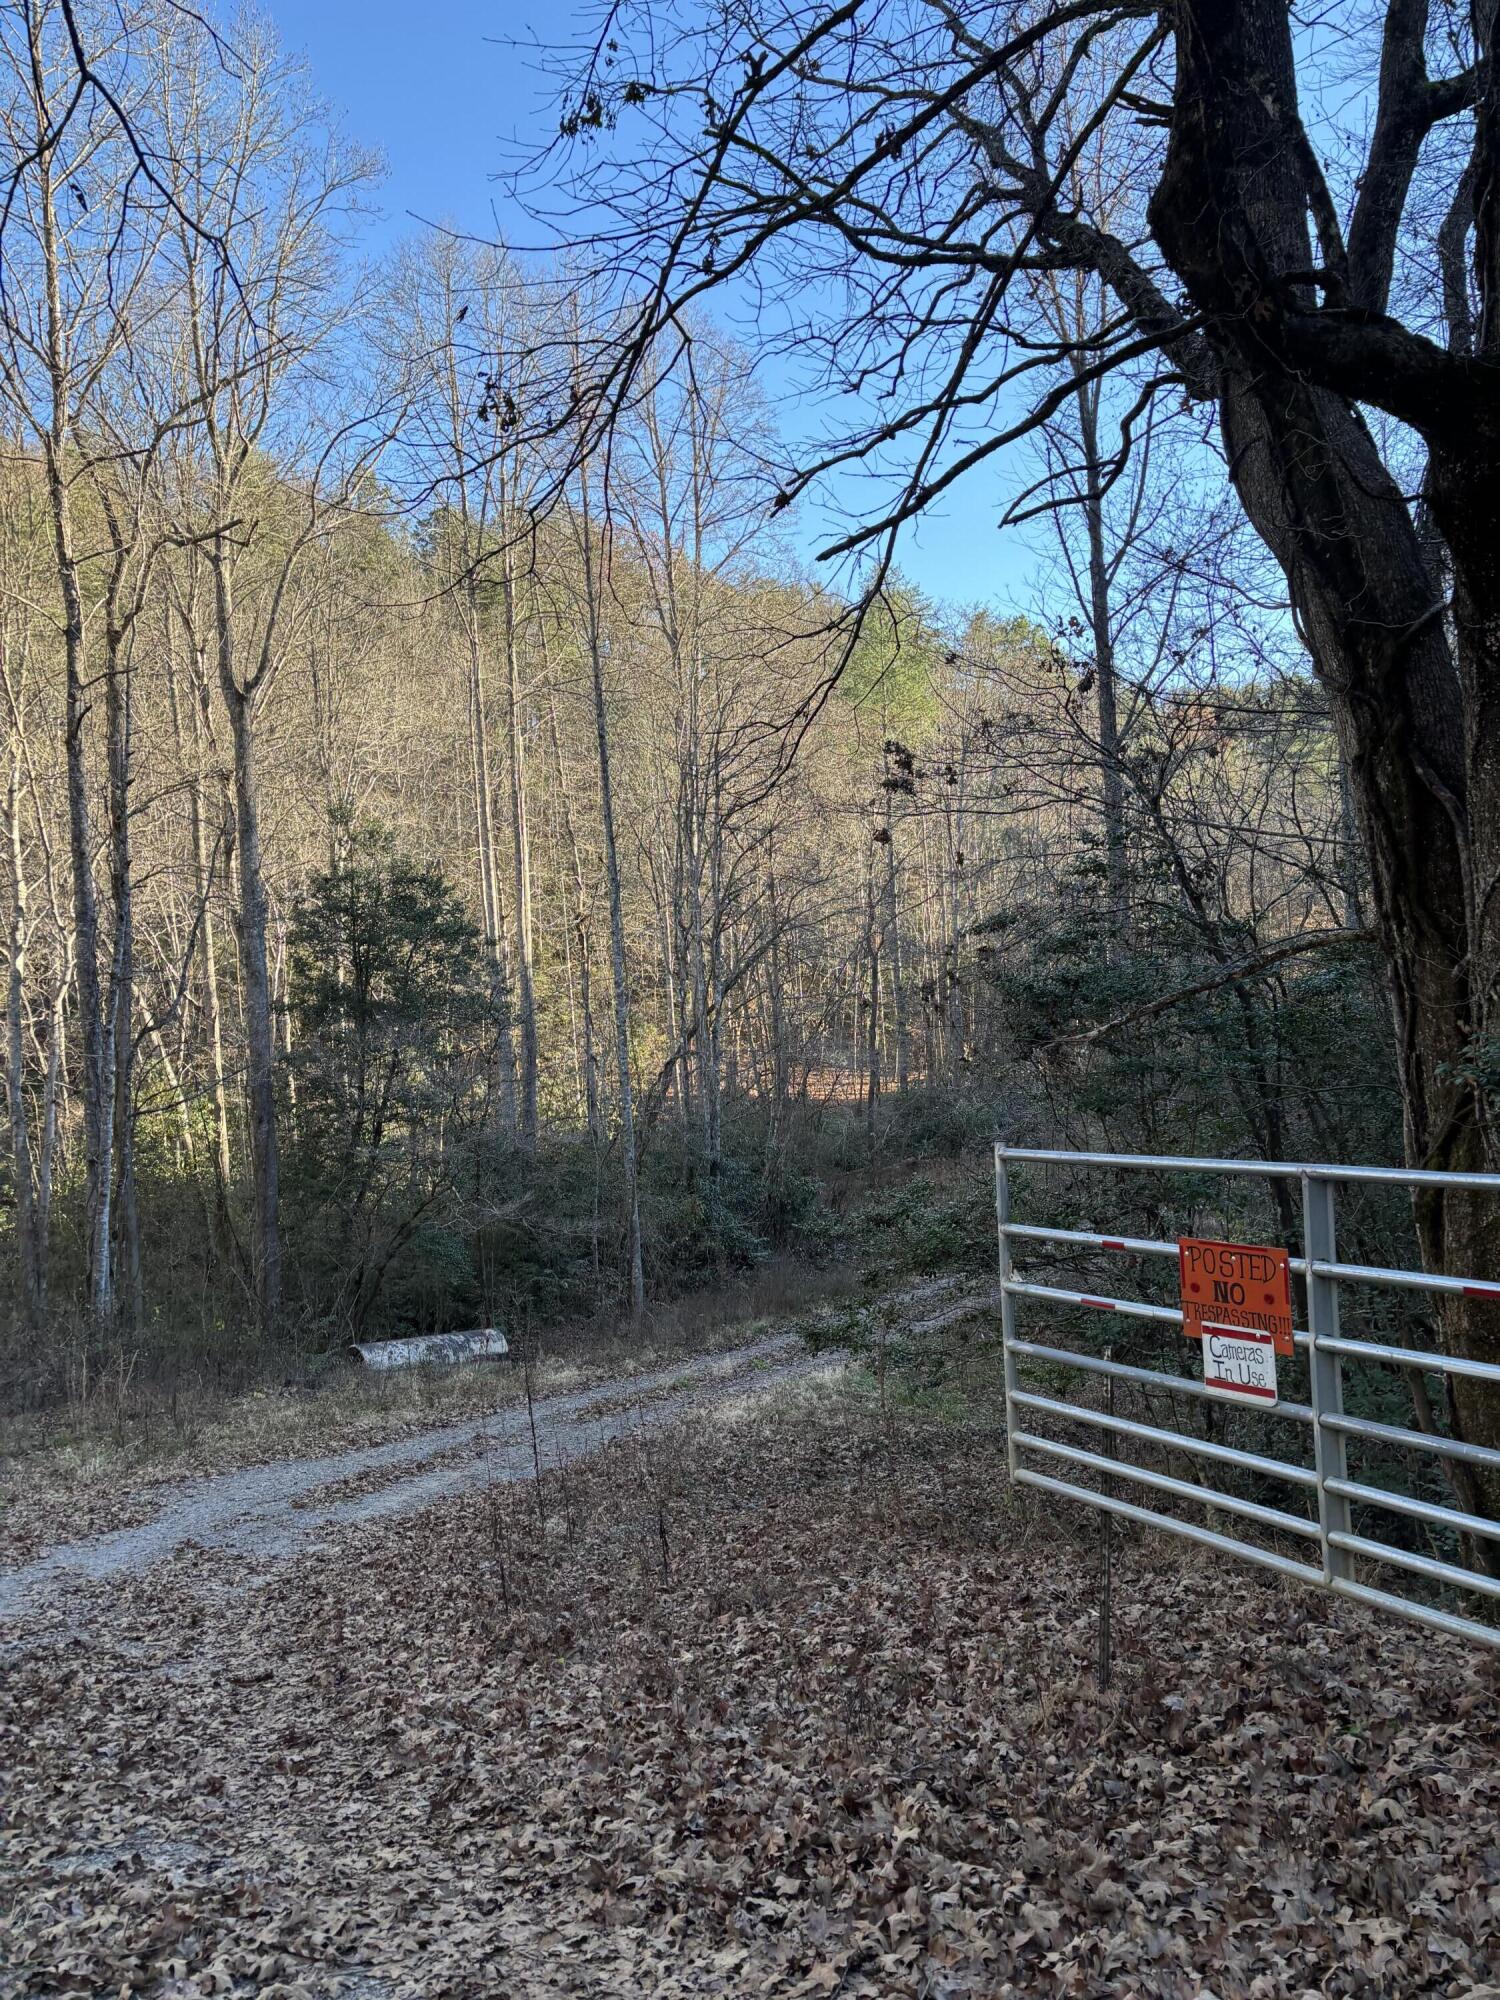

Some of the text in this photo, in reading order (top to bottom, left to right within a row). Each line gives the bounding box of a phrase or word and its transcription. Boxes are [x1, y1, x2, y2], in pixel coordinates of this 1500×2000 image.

[1186, 1246, 1276, 1284] POSTED
[1213, 1280, 1245, 1305] NO
[1210, 1335, 1264, 1364] Cameras
[1212, 1360, 1266, 1387] In Use
